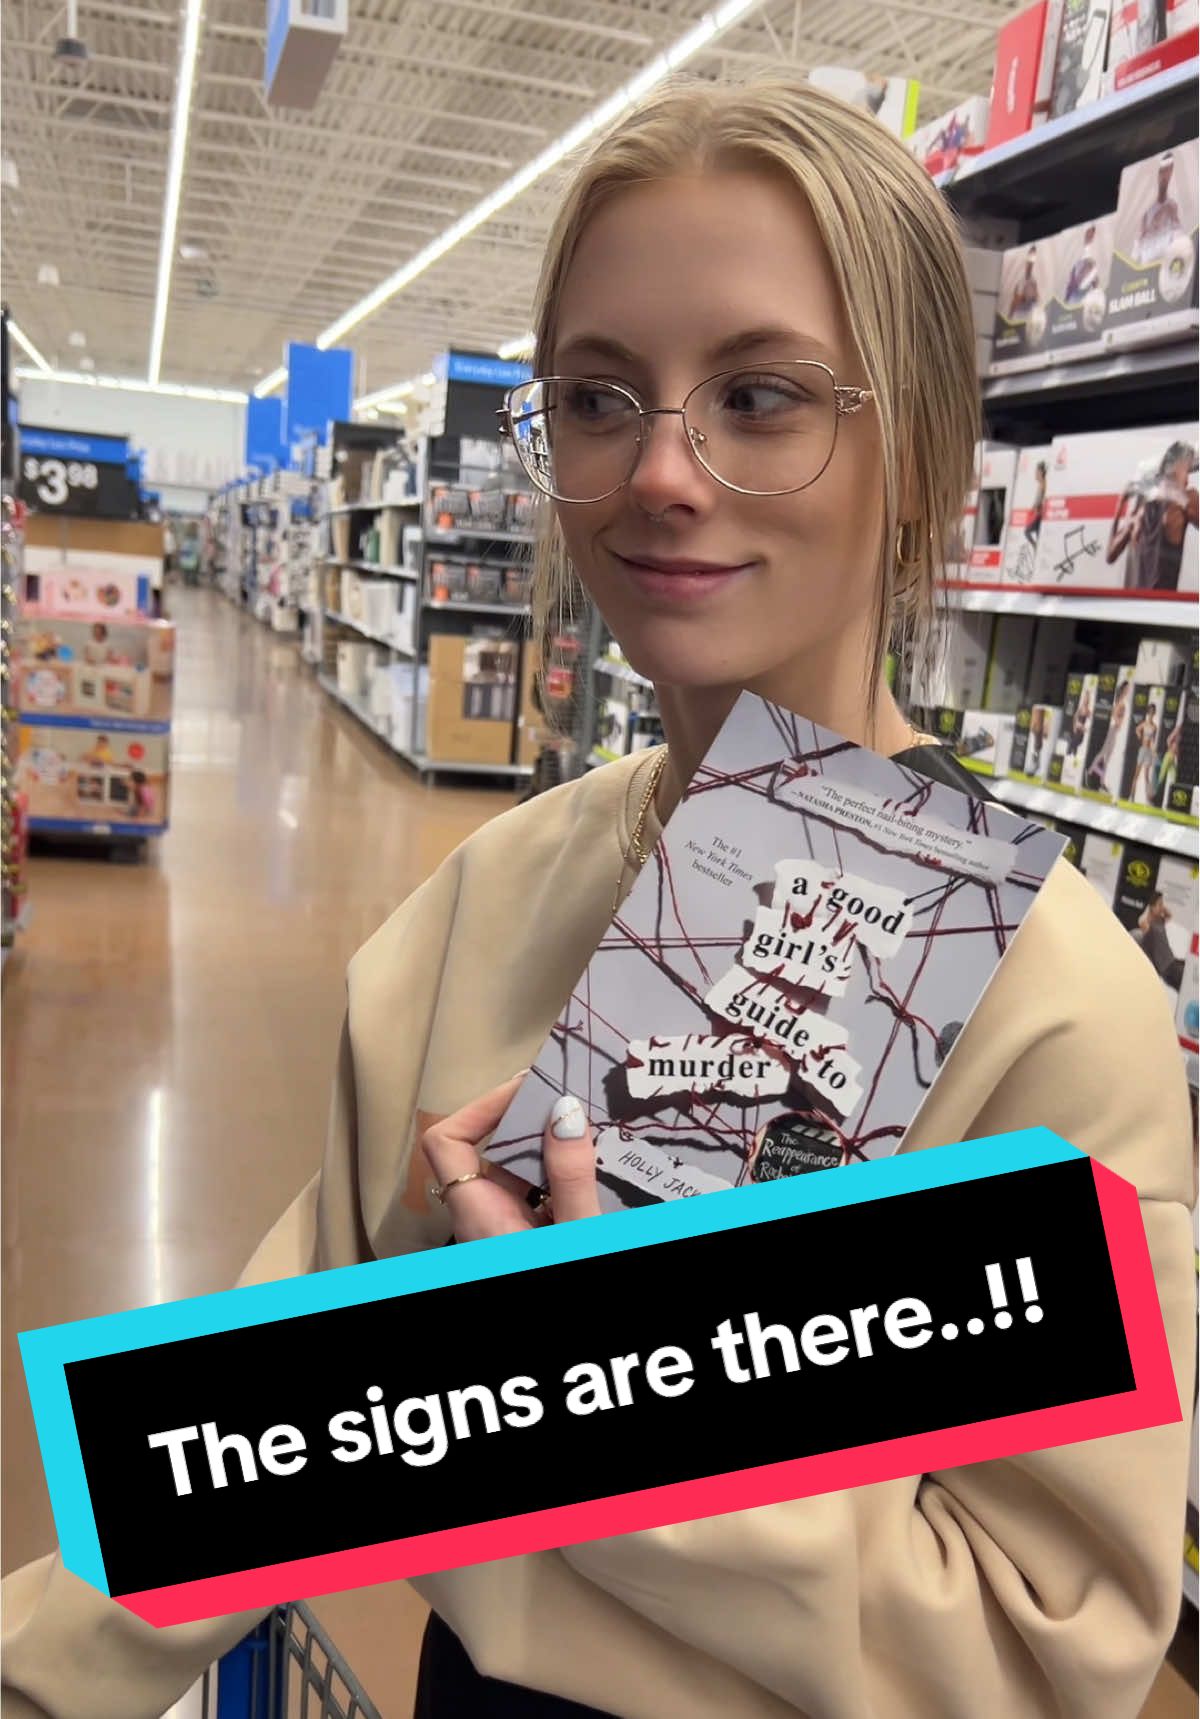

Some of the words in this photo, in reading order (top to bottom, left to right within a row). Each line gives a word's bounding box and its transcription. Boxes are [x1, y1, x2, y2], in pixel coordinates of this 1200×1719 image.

[842, 798, 877, 817] perfect
[876, 810, 925, 836] nail-biting
[684, 839, 706, 857] New
[706, 850, 727, 868] York
[727, 862, 753, 882] Times
[712, 836, 729, 852] The
[691, 858, 734, 888] bestseller
[791, 876, 809, 896] a
[826, 886, 905, 935] good
[752, 931, 839, 974] girl’s
[724, 990, 811, 1048] guide
[817, 1058, 848, 1090] to
[647, 1053, 772, 1080] murder
[762, 1137, 838, 1168] Reappearance
[779, 1132, 799, 1146] The
[618, 1150, 664, 1183] HOLLY
